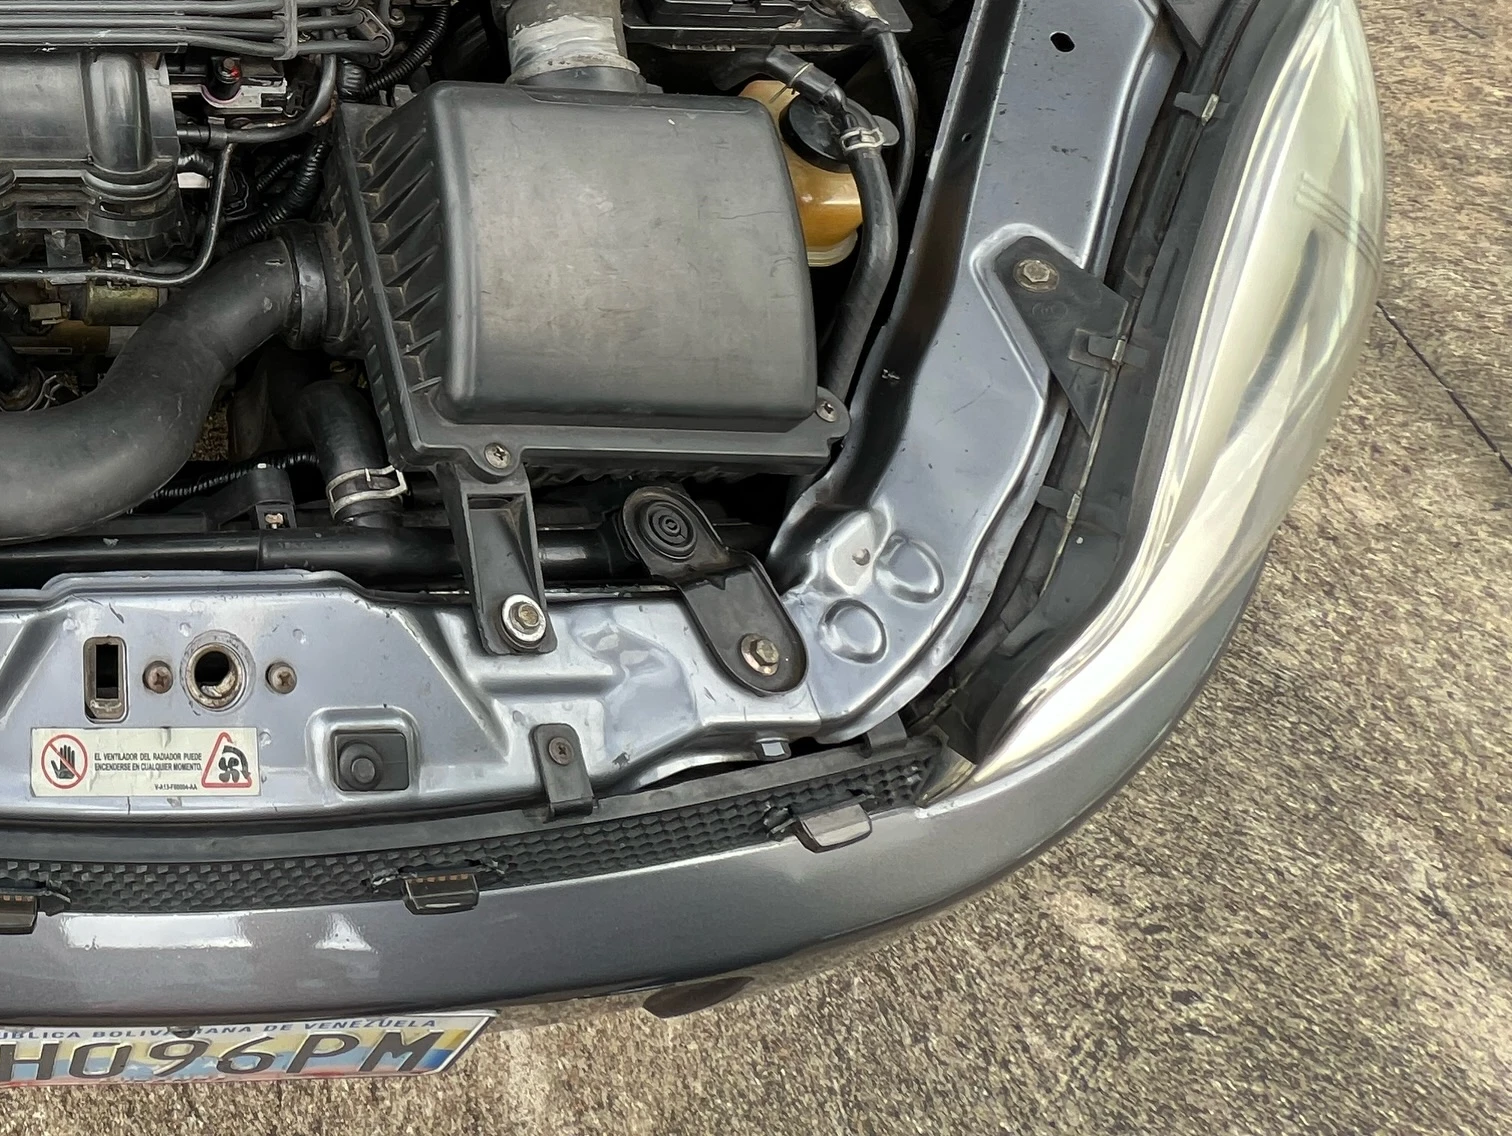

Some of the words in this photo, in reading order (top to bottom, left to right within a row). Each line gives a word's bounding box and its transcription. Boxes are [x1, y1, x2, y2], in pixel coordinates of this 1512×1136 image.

[94, 752, 101, 761] EL
[103, 752, 138, 761] VENTILADOR
[139, 752, 151, 761] DEL
[152, 752, 181, 761] RADIADOR
[183, 752, 202, 761] PUEDE
[94, 762, 131, 771] ENCENDERSE
[132, 762, 140, 771] EN
[141, 762, 172, 771] CUALQUIER
[92, 1025, 252, 1038] BOLIVIANA
[264, 1023, 286, 1032] DE
[304, 1017, 437, 1031] VENEZUELA
